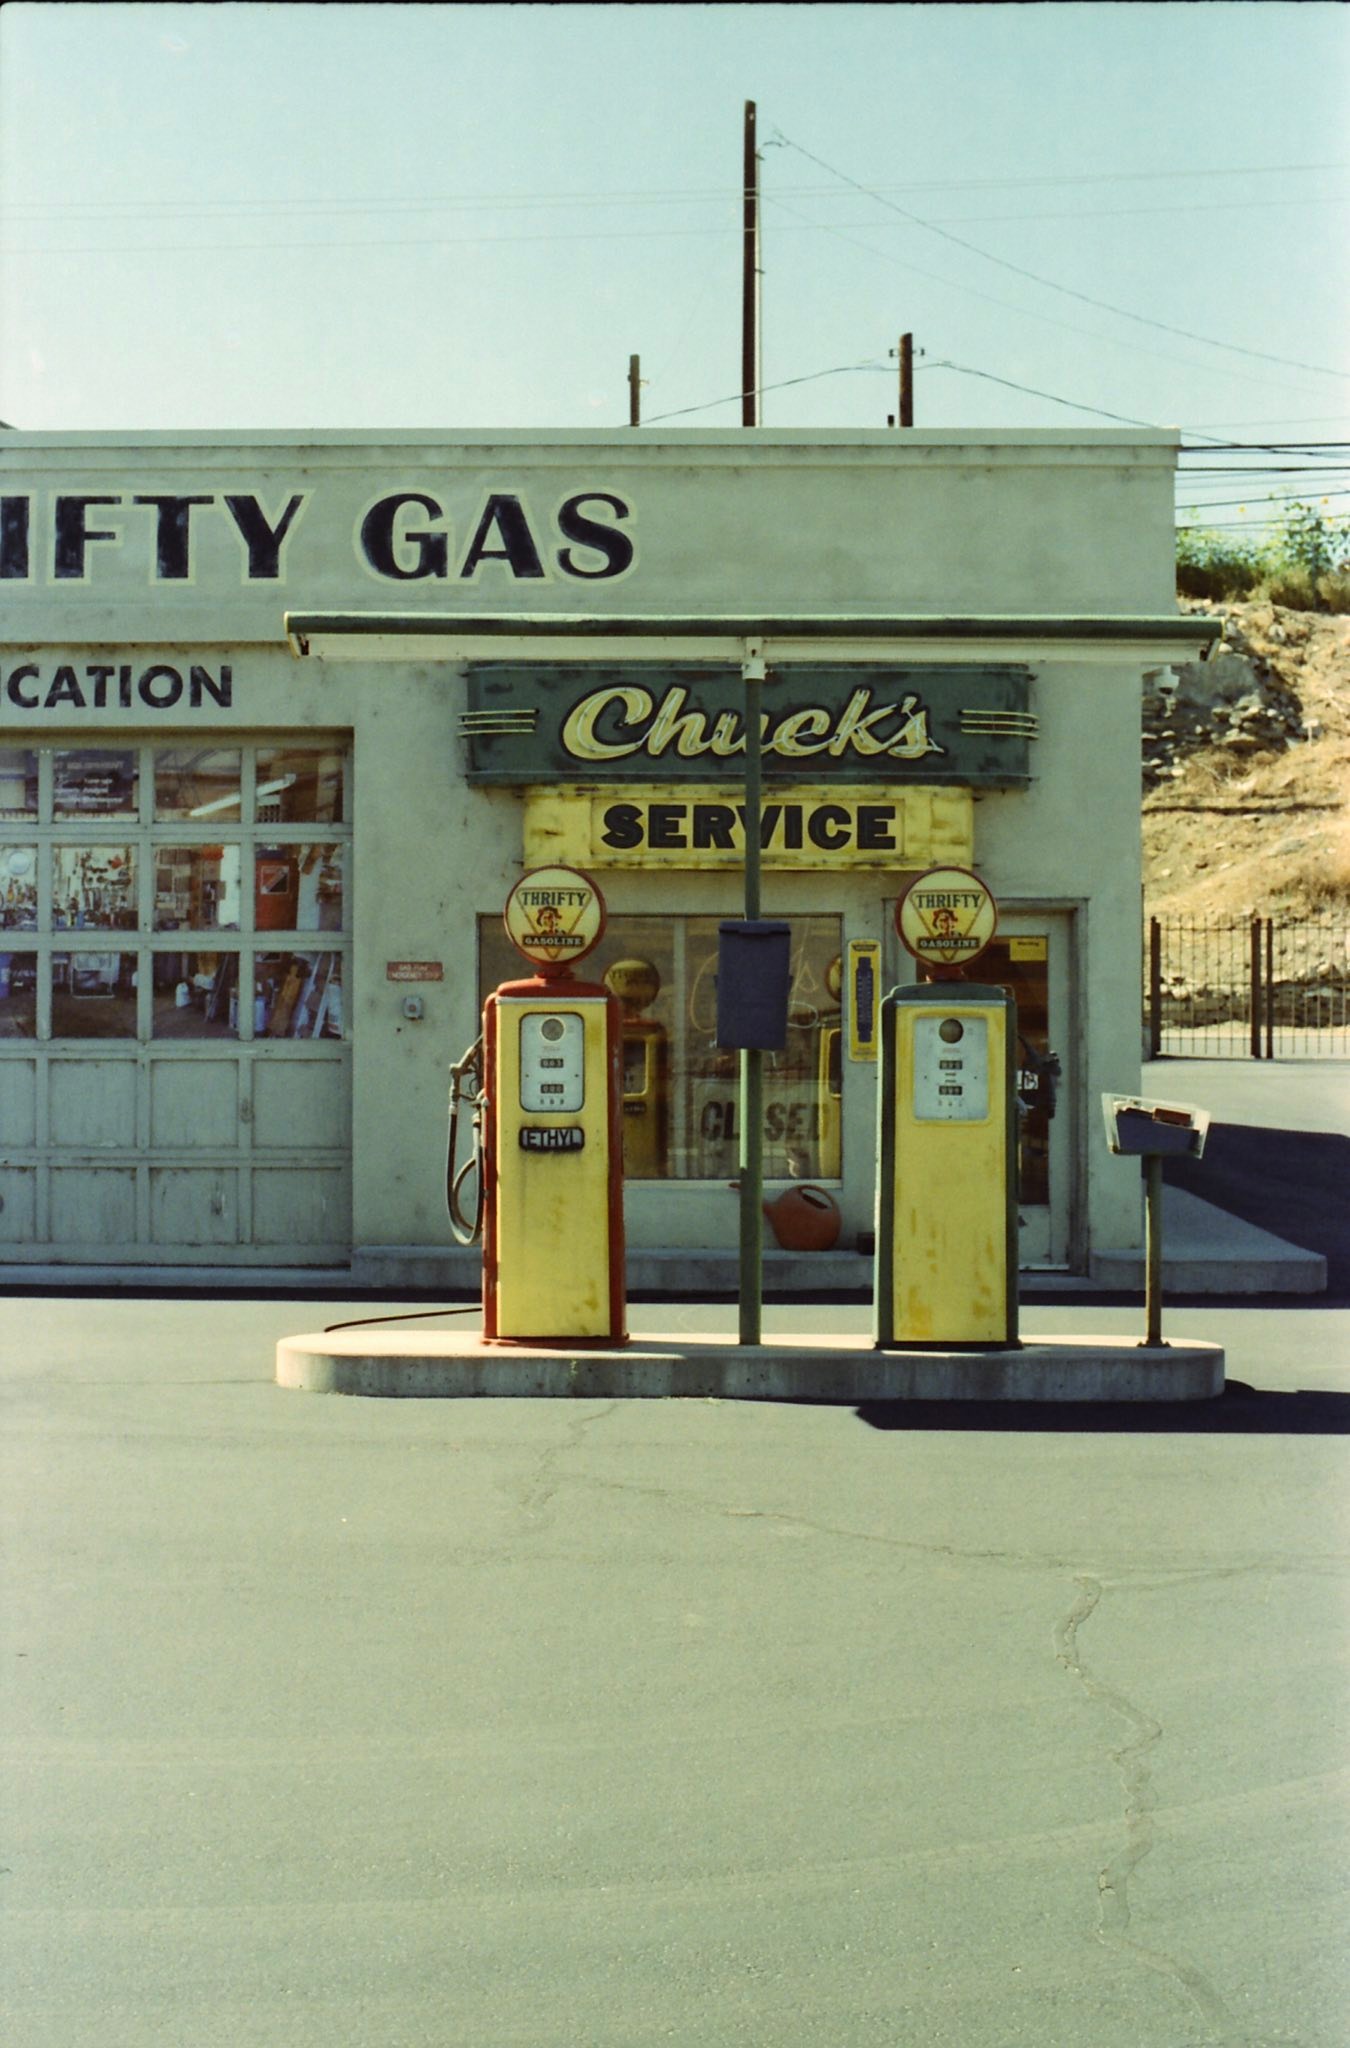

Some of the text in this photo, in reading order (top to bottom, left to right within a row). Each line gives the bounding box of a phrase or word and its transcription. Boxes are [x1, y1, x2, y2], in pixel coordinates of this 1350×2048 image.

[0, 492, 634, 580] IFTY GAS
[7, 665, 232, 708] CATION
[562, 686, 945, 760] Chuck's
[601, 804, 896, 850] SERVICE
[522, 892, 586, 906] THRIFTY
[916, 894, 981, 908] THRIFTY
[525, 937, 581, 945] GASOLINE
[920, 939, 977, 948] GASOLINE
[701, 1100, 829, 1142] CLSED
[526, 1128, 582, 1147] ETHYL
